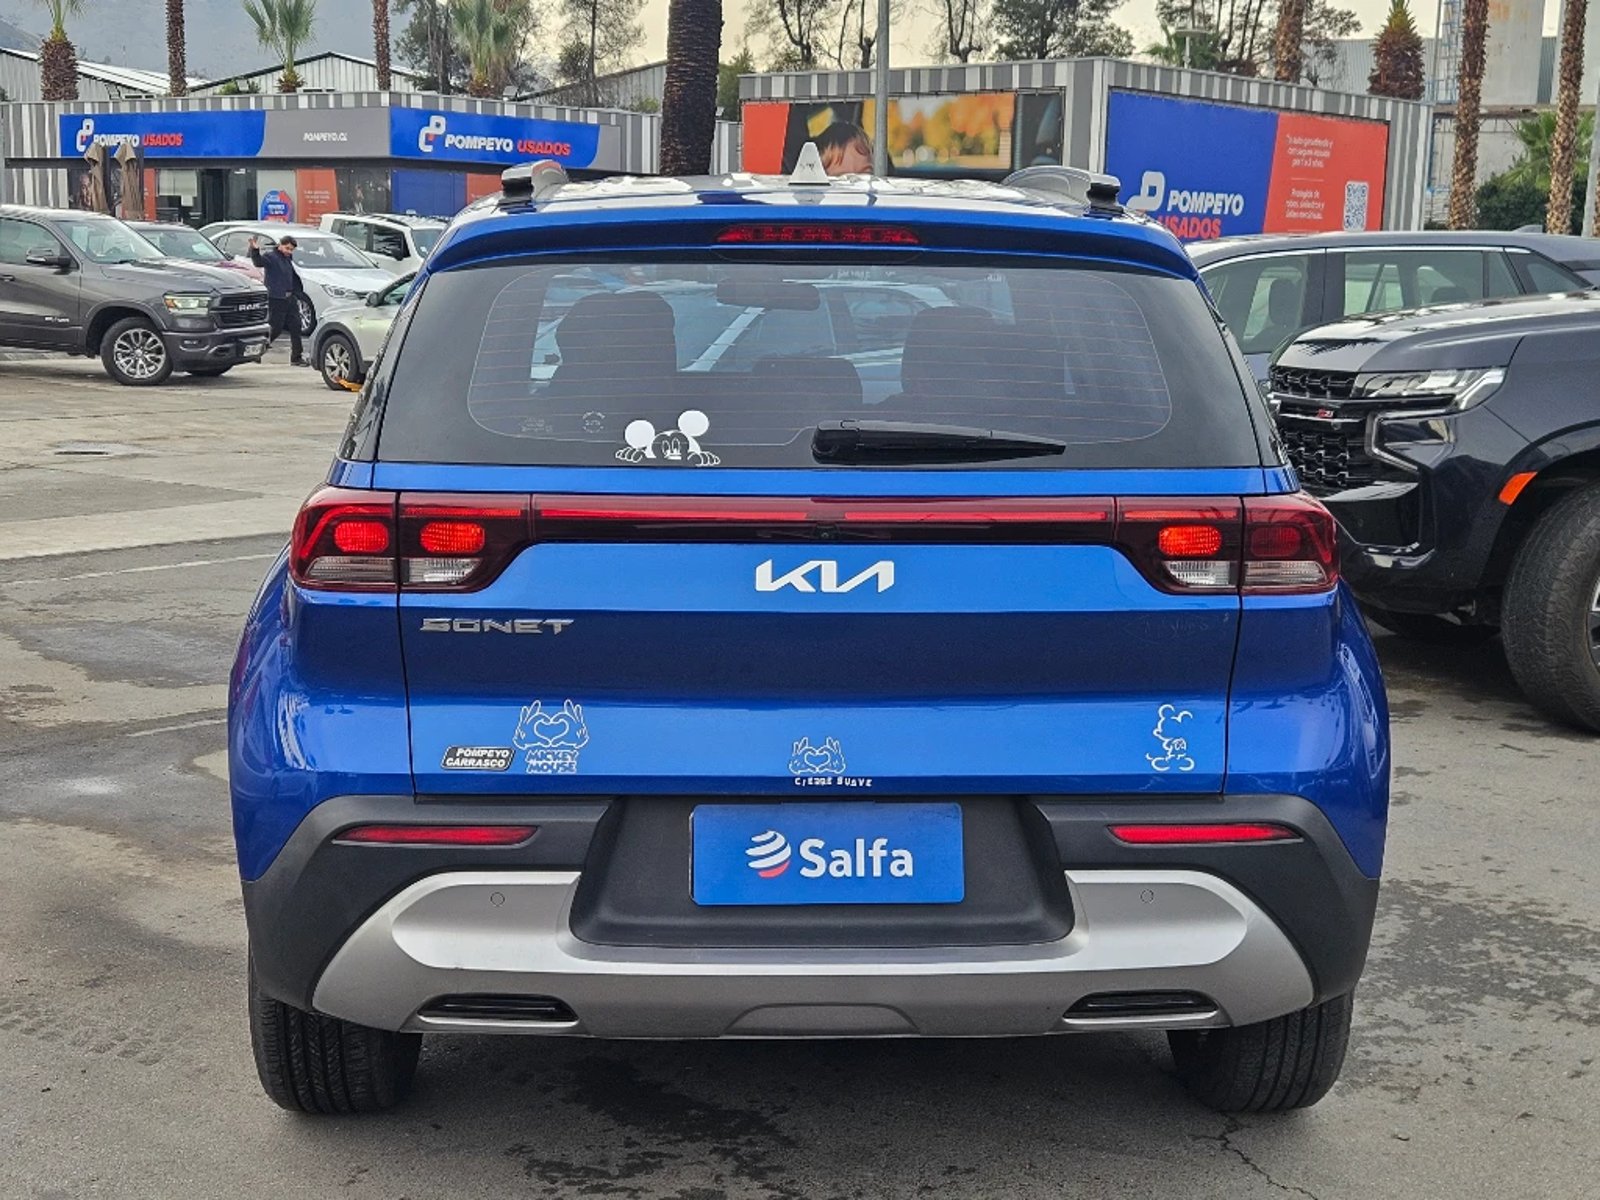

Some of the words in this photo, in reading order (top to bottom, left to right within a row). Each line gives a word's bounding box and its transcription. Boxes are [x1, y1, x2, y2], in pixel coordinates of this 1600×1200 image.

[142, 133, 183, 146] USADOS
[445, 134, 513, 153] POMPEYO
[516, 140, 571, 156] USADOS
[1167, 189, 1245, 216] POMPEYO
[755, 559, 895, 593] KIA
[419, 617, 575, 635] SONET
[456, 748, 510, 758] POMPEYO
[526, 750, 579, 762] MICKEY
[446, 758, 506, 768] CARRASCO
[526, 761, 577, 774] MOUSE
[799, 838, 913, 878] Salfa
